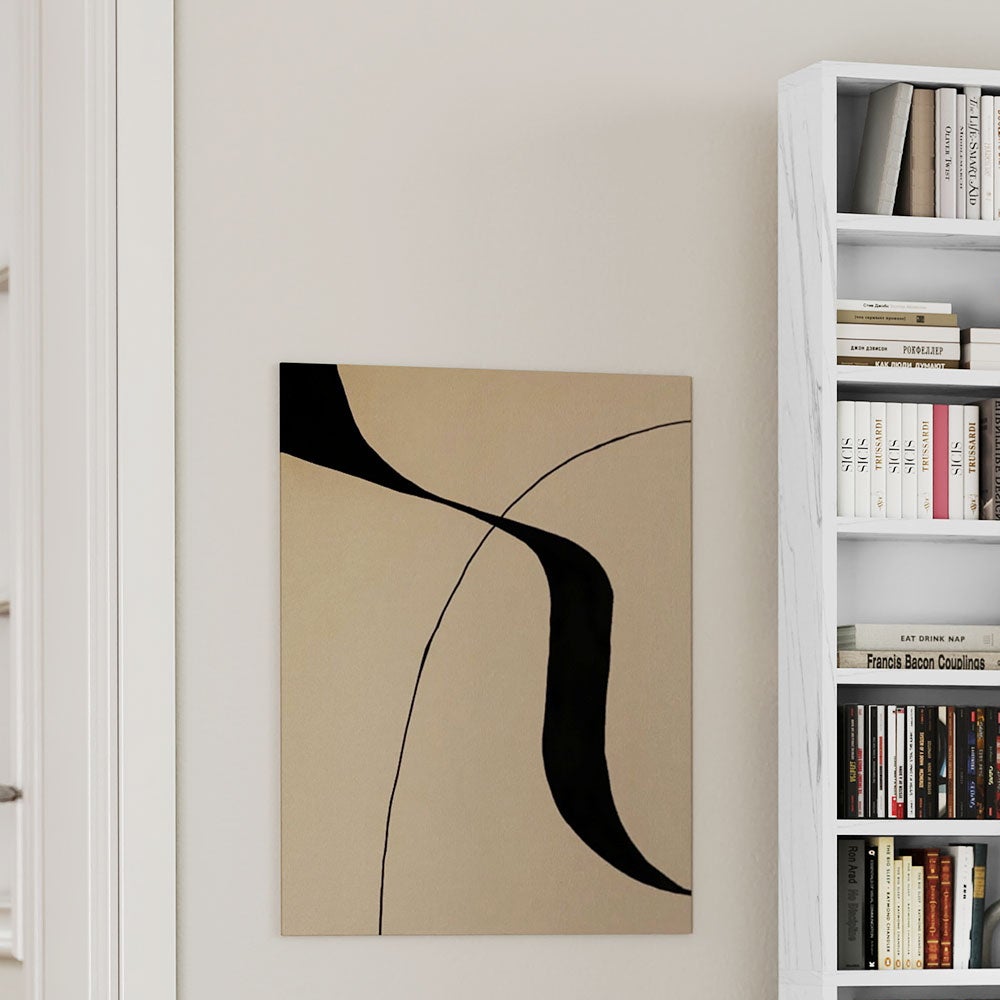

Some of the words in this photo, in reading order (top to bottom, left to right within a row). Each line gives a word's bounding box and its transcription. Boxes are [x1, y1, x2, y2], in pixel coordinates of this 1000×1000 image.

[944, 126, 952, 155] OLIVER
[944, 157, 952, 180] TWIST
[902, 345, 944, 355] РОКФЕЛЛЕР
[875, 419, 883, 471] TRUSSARDI
[921, 421, 929, 472] TRUSSARDI
[968, 422, 976, 474] TRUSSARDI
[867, 653, 902, 670] Francis
[905, 654, 934, 670] Bacon
[938, 654, 986, 670] Couplings
[848, 846, 858, 862] Ron
[848, 864, 858, 884] Arad
